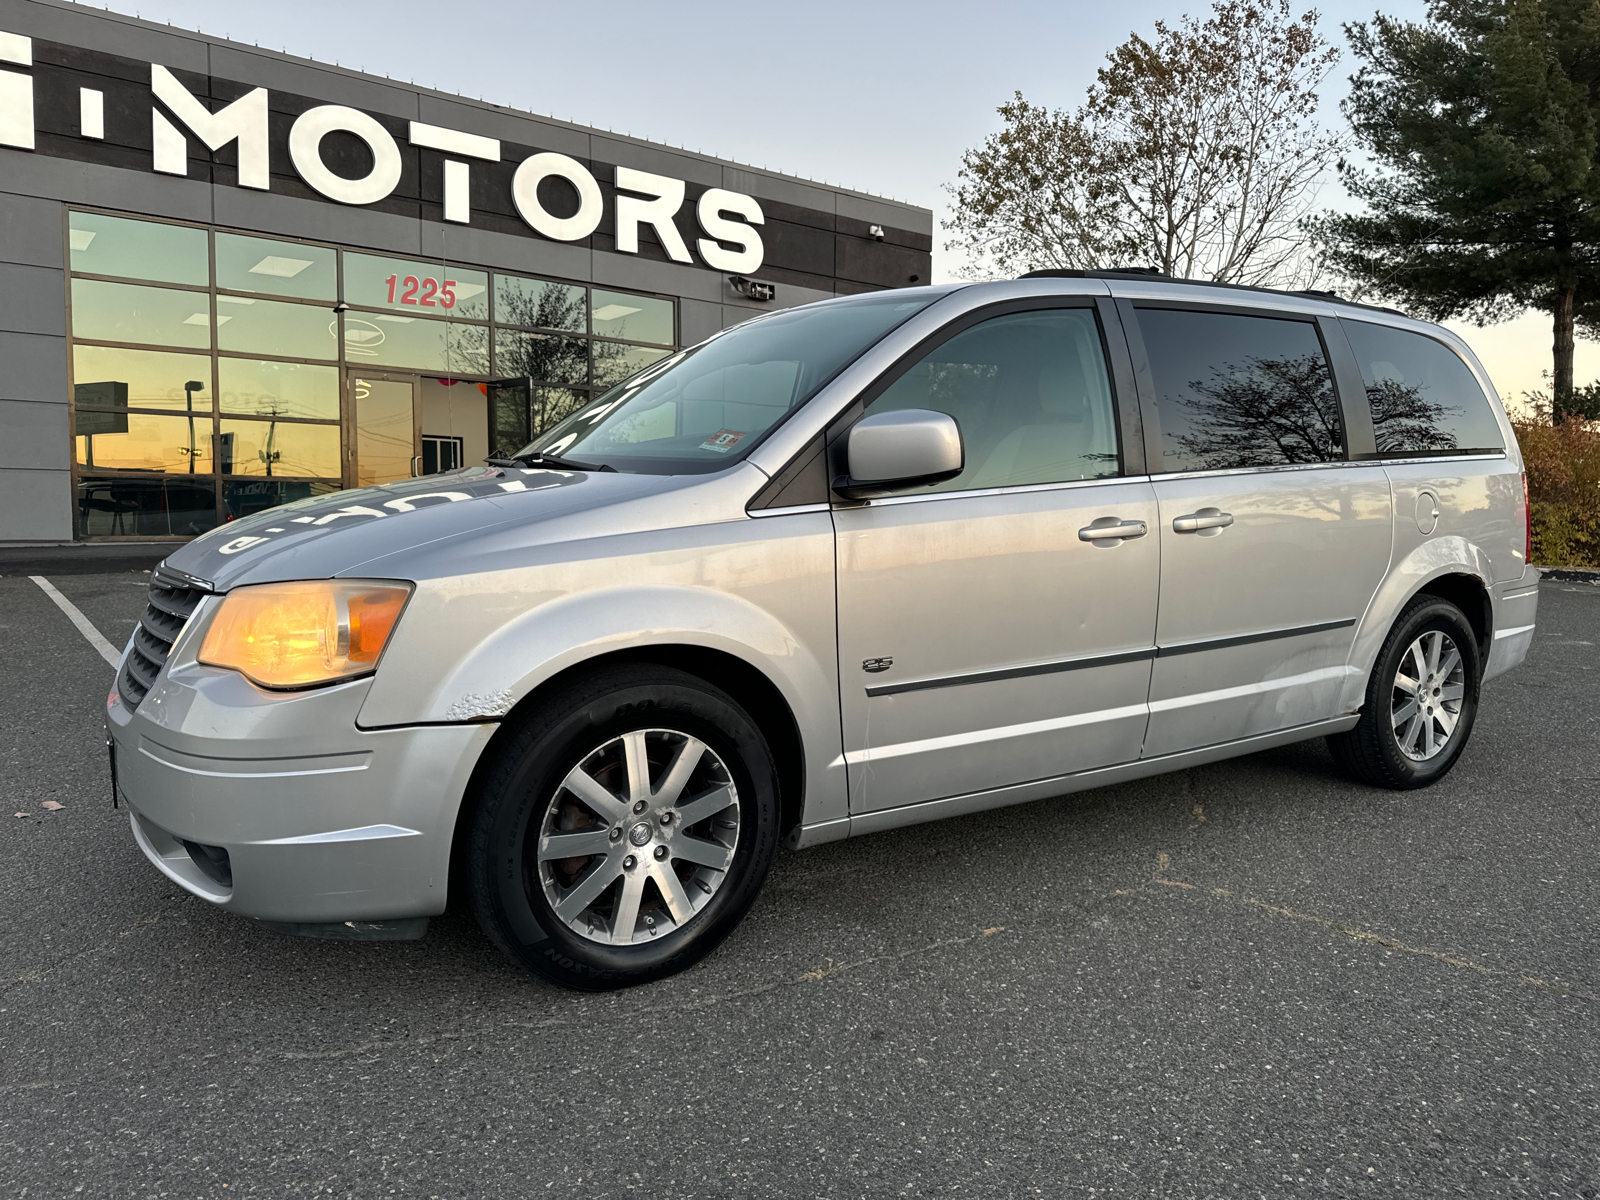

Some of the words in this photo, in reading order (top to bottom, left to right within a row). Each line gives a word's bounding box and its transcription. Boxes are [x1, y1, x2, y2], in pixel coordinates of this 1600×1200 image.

[151, 63, 766, 275] MOTORS
[385, 273, 457, 309] 1225
[615, 698, 740, 740] DOUGLAS
